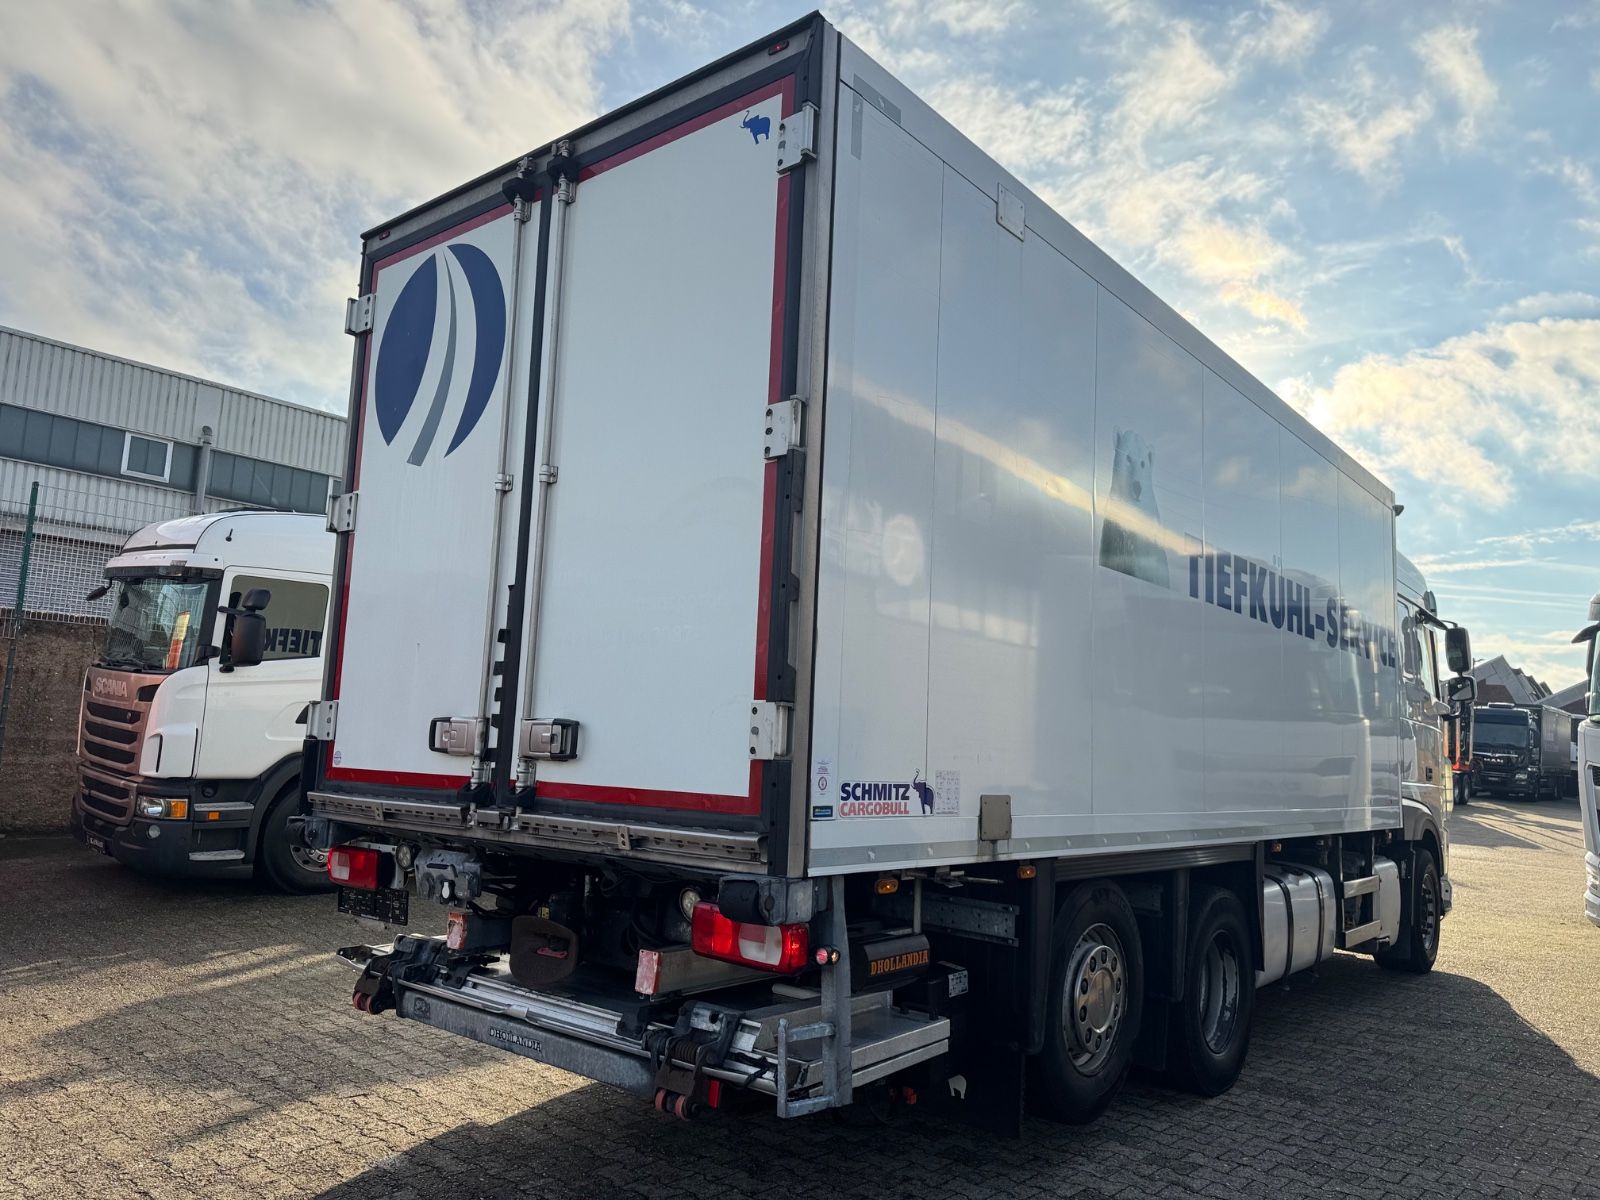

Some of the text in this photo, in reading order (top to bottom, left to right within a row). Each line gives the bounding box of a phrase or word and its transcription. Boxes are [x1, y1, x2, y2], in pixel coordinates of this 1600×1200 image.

[95, 676, 128, 698] SCANIA
[840, 782, 911, 802] SCHMITZ
[840, 801, 910, 817] CARGOBULL
[870, 950, 929, 977] DHOLLANDIA
[489, 1026, 542, 1051] DHOLLANDIA
